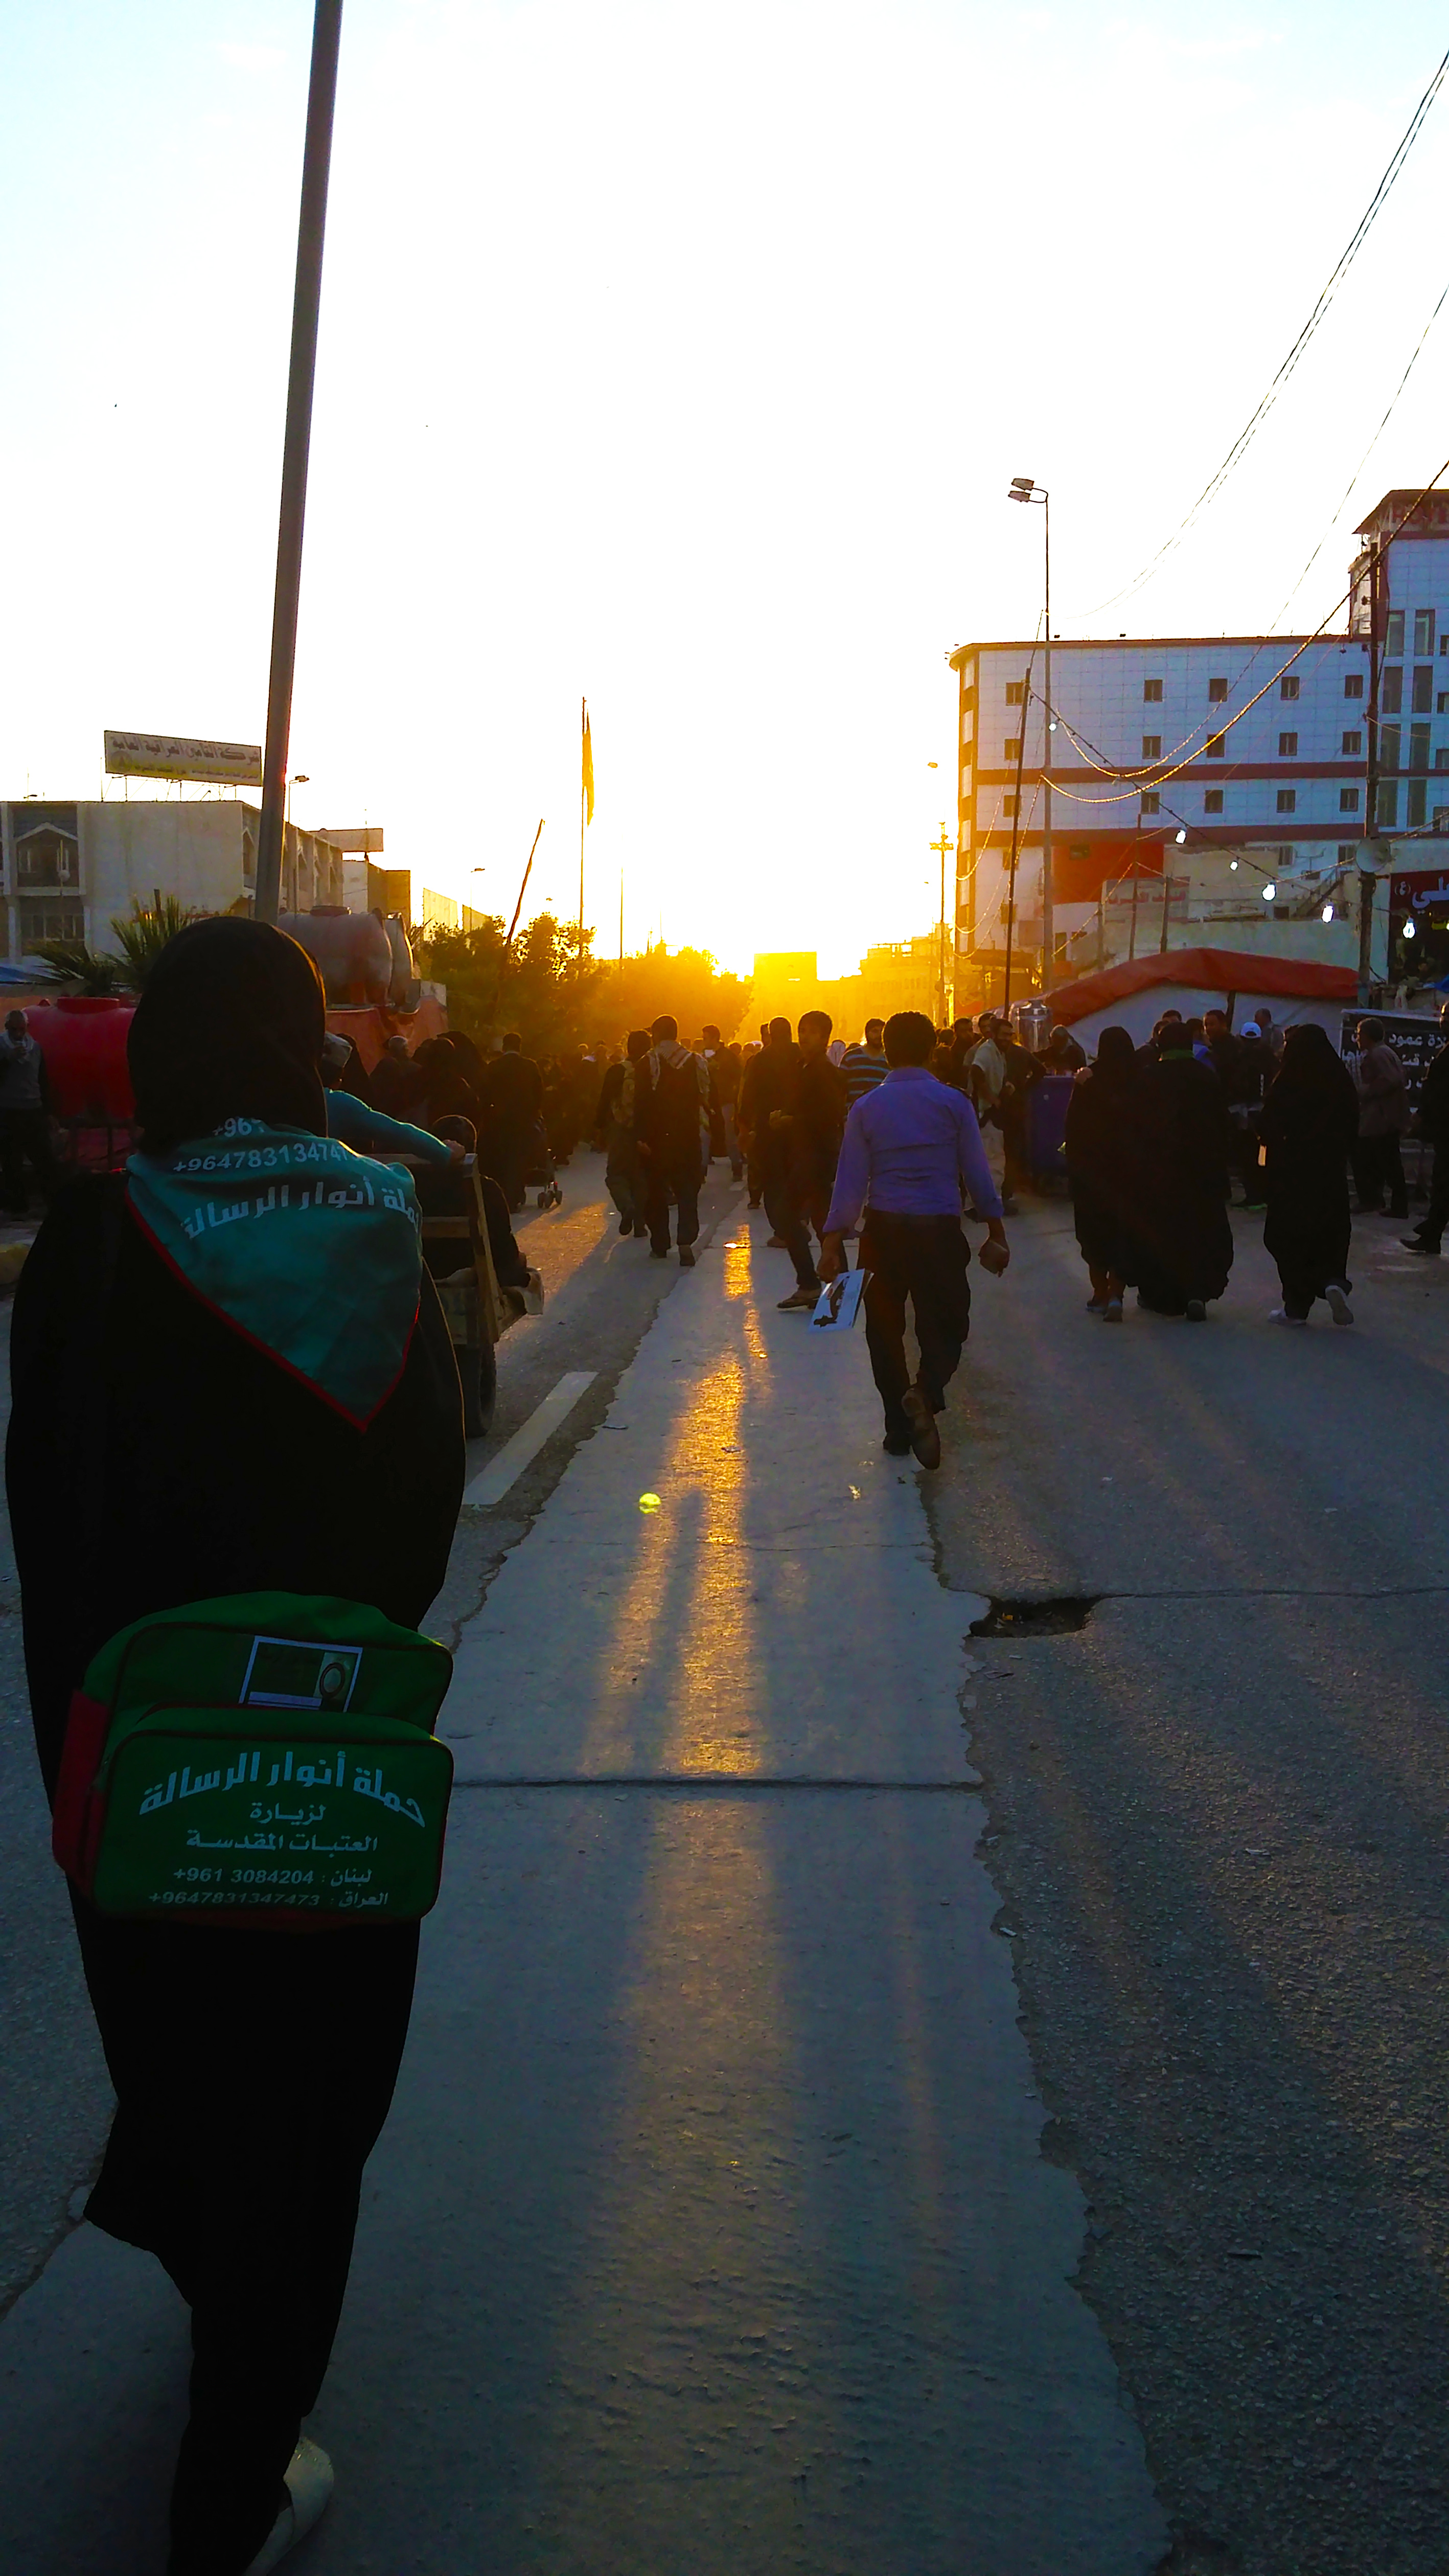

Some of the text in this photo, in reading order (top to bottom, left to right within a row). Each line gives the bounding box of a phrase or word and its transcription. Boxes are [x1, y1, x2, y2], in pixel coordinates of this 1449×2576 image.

[110, 734, 143, 751] العامة
[144, 738, 185, 758] العراقية
[218, 747, 260, 765] شركة
[298, 1175, 375, 1211] أنوار
[139, 1750, 426, 1828] حملة أنوار الرسالة
[249, 1802, 327, 1827] لزيارة
[186, 1829, 378, 1859] العتبات المقدسة
[173, 1867, 224, 1883] +961
[230, 1868, 314, 1885] 3084204
[330, 1867, 373, 1887] لبنان
[148, 1890, 321, 1907] +9647831347473
[338, 1890, 389, 1909] العراق
